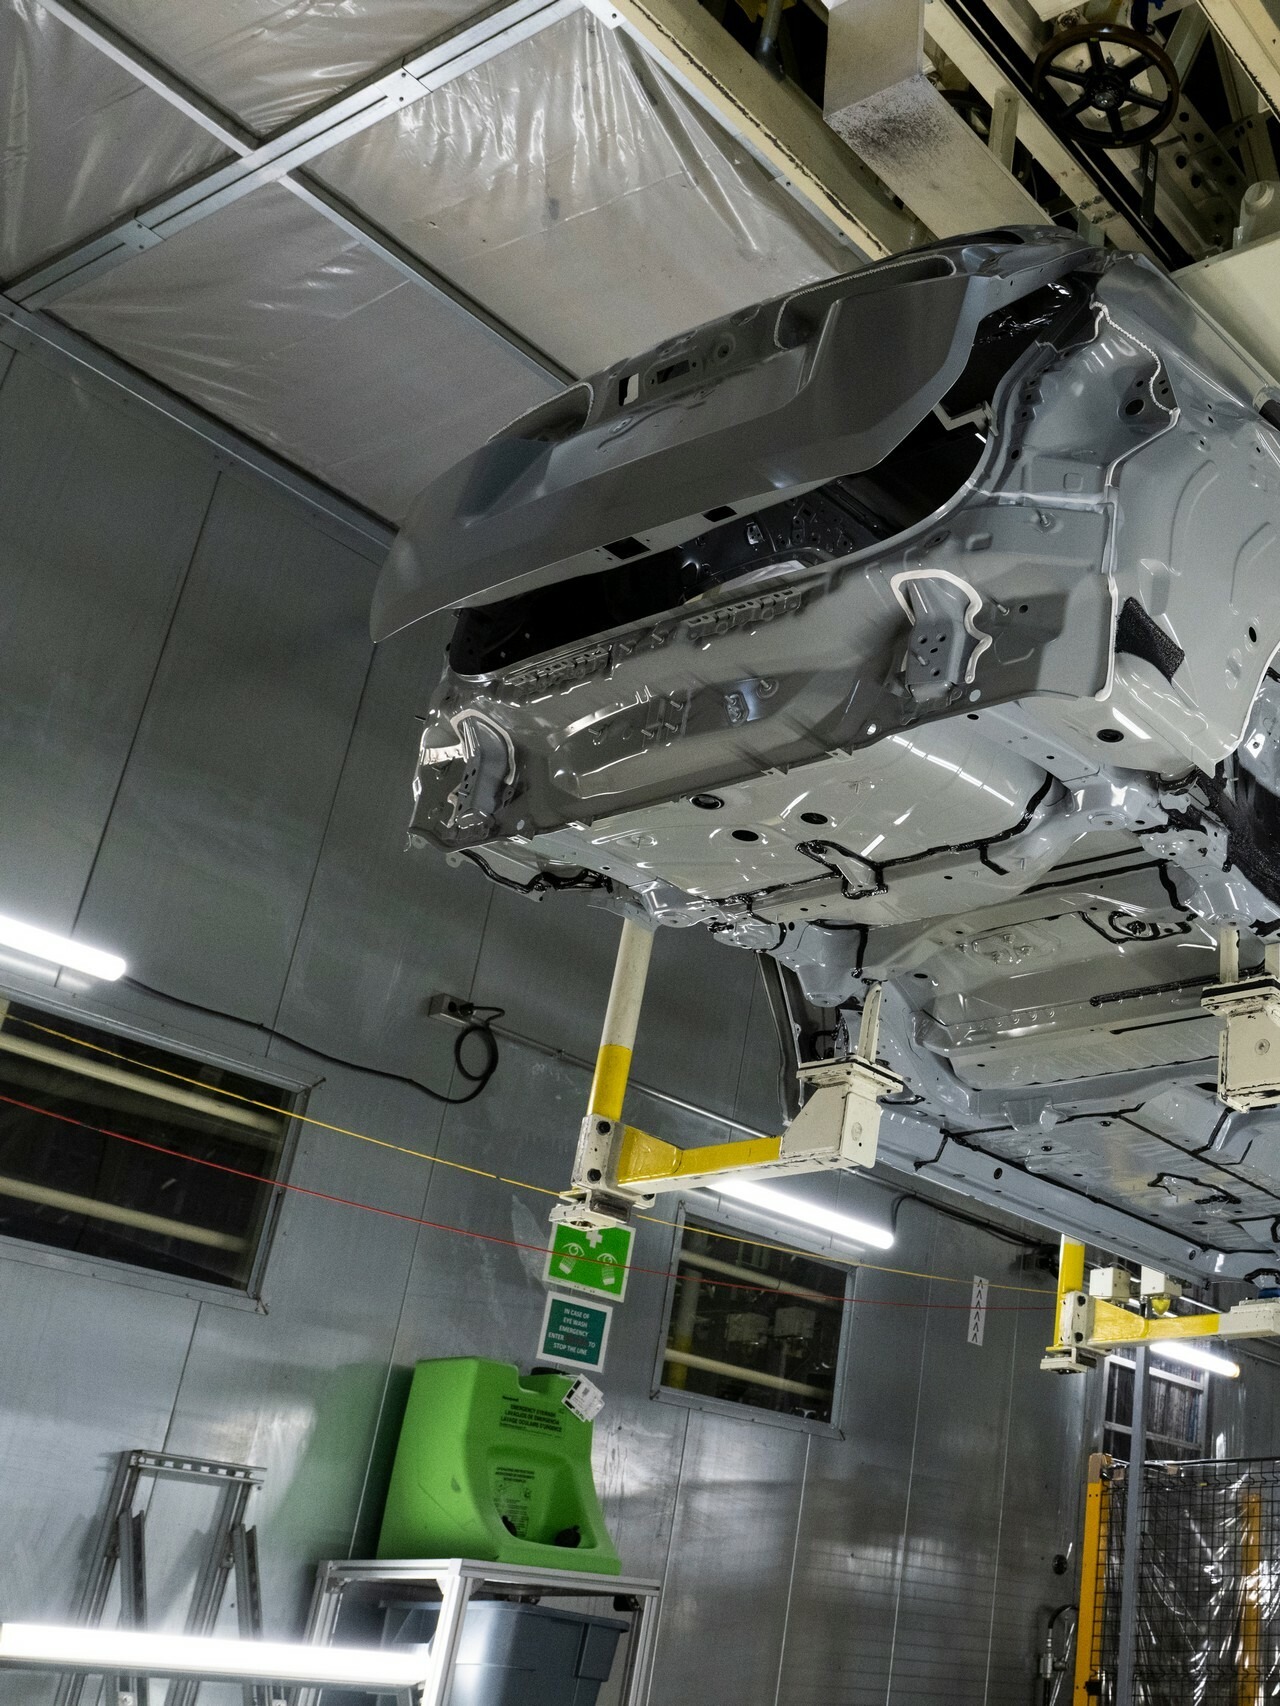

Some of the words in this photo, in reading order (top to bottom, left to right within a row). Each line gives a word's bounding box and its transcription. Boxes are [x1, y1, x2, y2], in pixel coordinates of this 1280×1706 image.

[571, 1310, 583, 1318] CASE
[573, 1320, 588, 1328] WASH
[559, 1325, 589, 1337] EMERGENCY
[549, 1332, 564, 1340] ENTER
